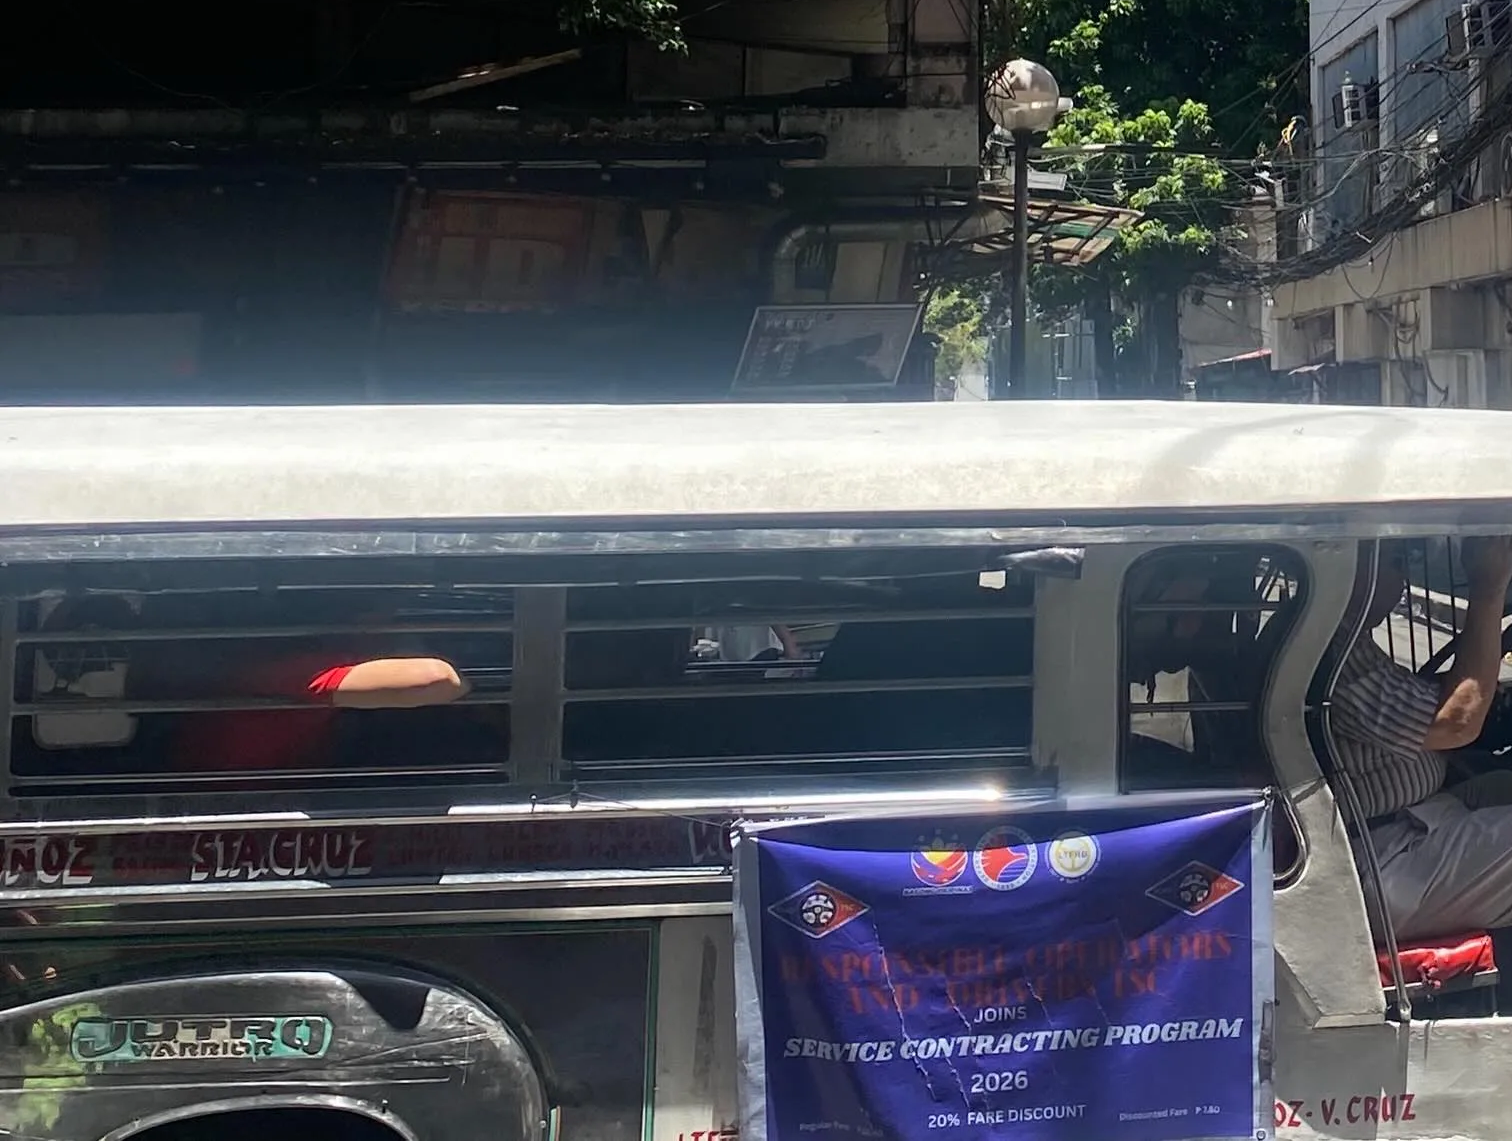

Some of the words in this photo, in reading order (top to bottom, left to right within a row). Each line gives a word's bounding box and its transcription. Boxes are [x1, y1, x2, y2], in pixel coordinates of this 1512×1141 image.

[974, 1005, 1028, 1024] JOINS
[131, 1041, 274, 1058] WARRIOR
[784, 1037, 895, 1063] SERVICE
[900, 1025, 1099, 1061] CONTRACTING
[1103, 1017, 1245, 1047] PROGRAM
[971, 1071, 1029, 1095] 2026
[927, 1113, 961, 1130] 20%
[967, 1110, 1005, 1126] FARE
[1008, 1104, 1087, 1124] DISCOUNT
[1346, 1093, 1416, 1125] CRUZ
